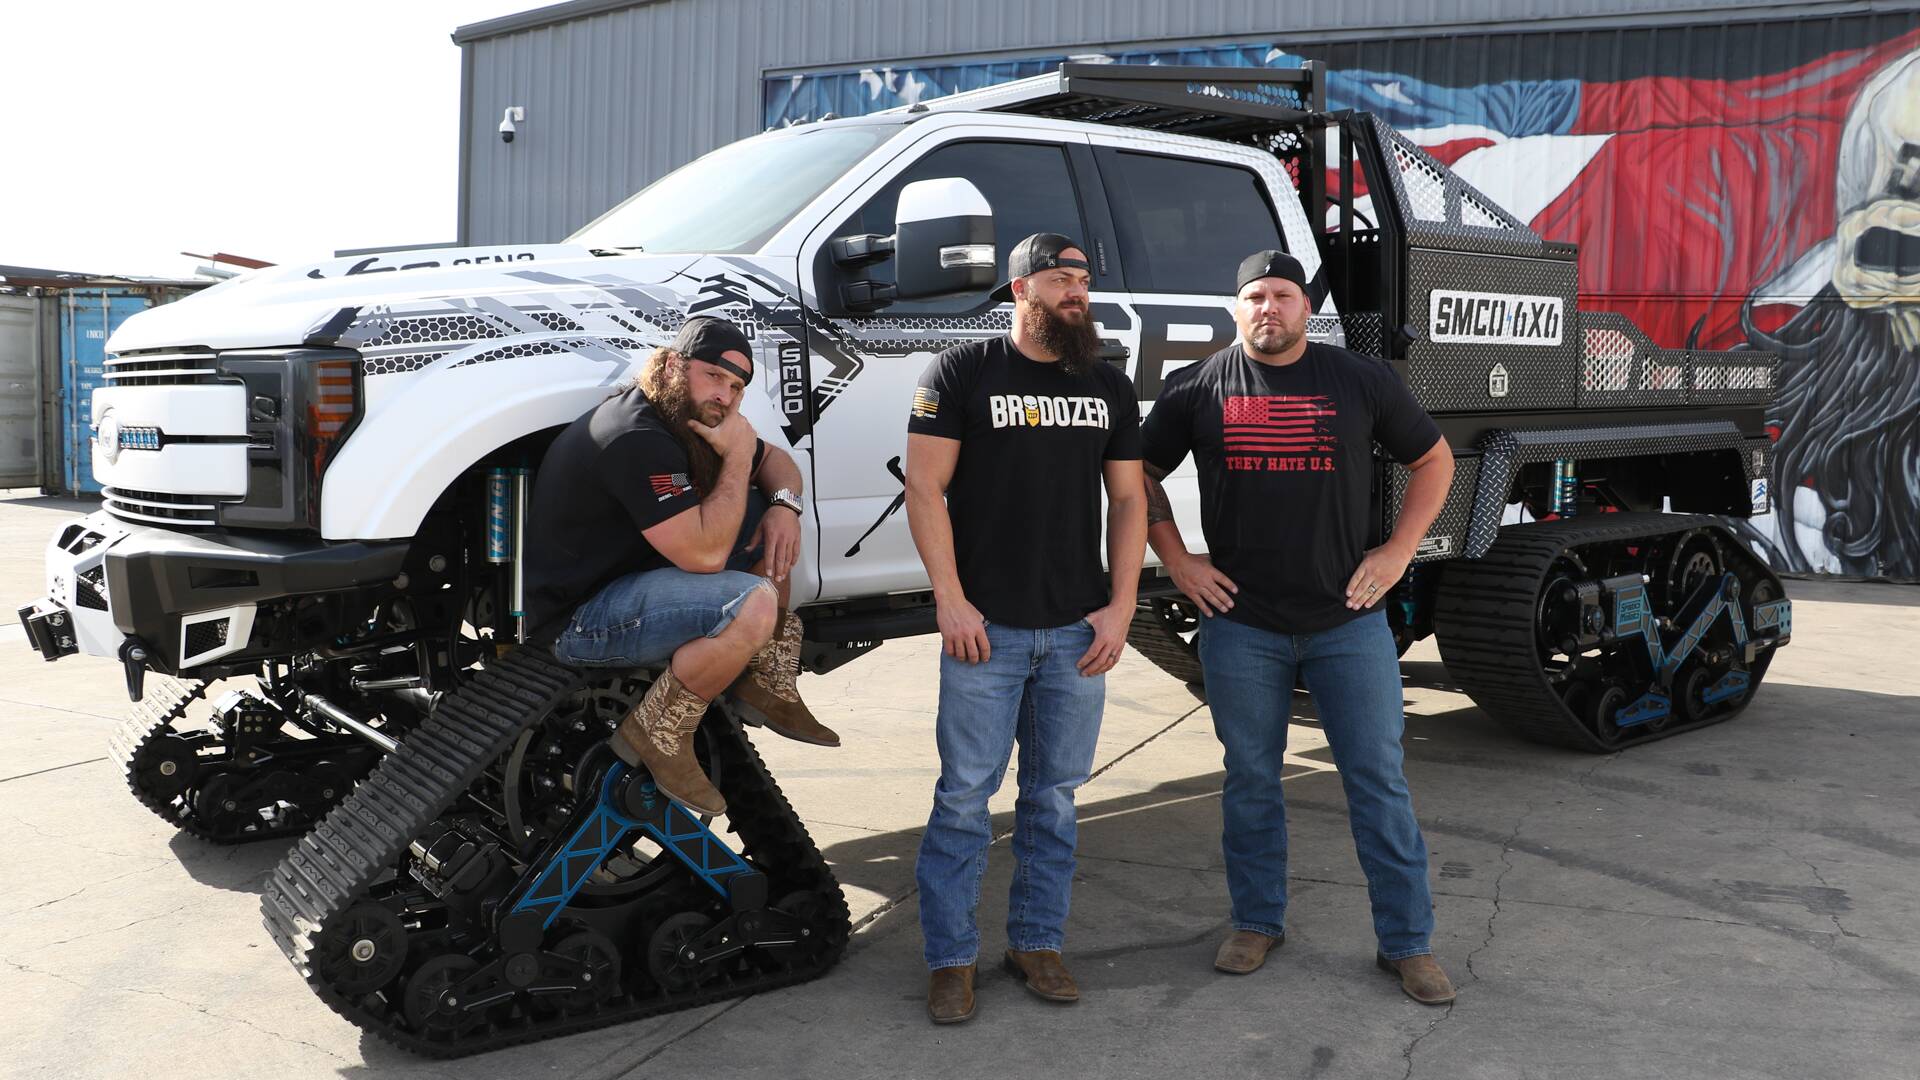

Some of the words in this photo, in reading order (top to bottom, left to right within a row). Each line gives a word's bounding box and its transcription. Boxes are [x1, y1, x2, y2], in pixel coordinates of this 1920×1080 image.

[1435, 296, 1506, 337] SMCO
[781, 348, 804, 414] SMCO
[1225, 456, 1263, 471] THEY
[1267, 457, 1306, 471] HATE
[1310, 457, 1336, 471] U.S.
[491, 481, 503, 553] KING
